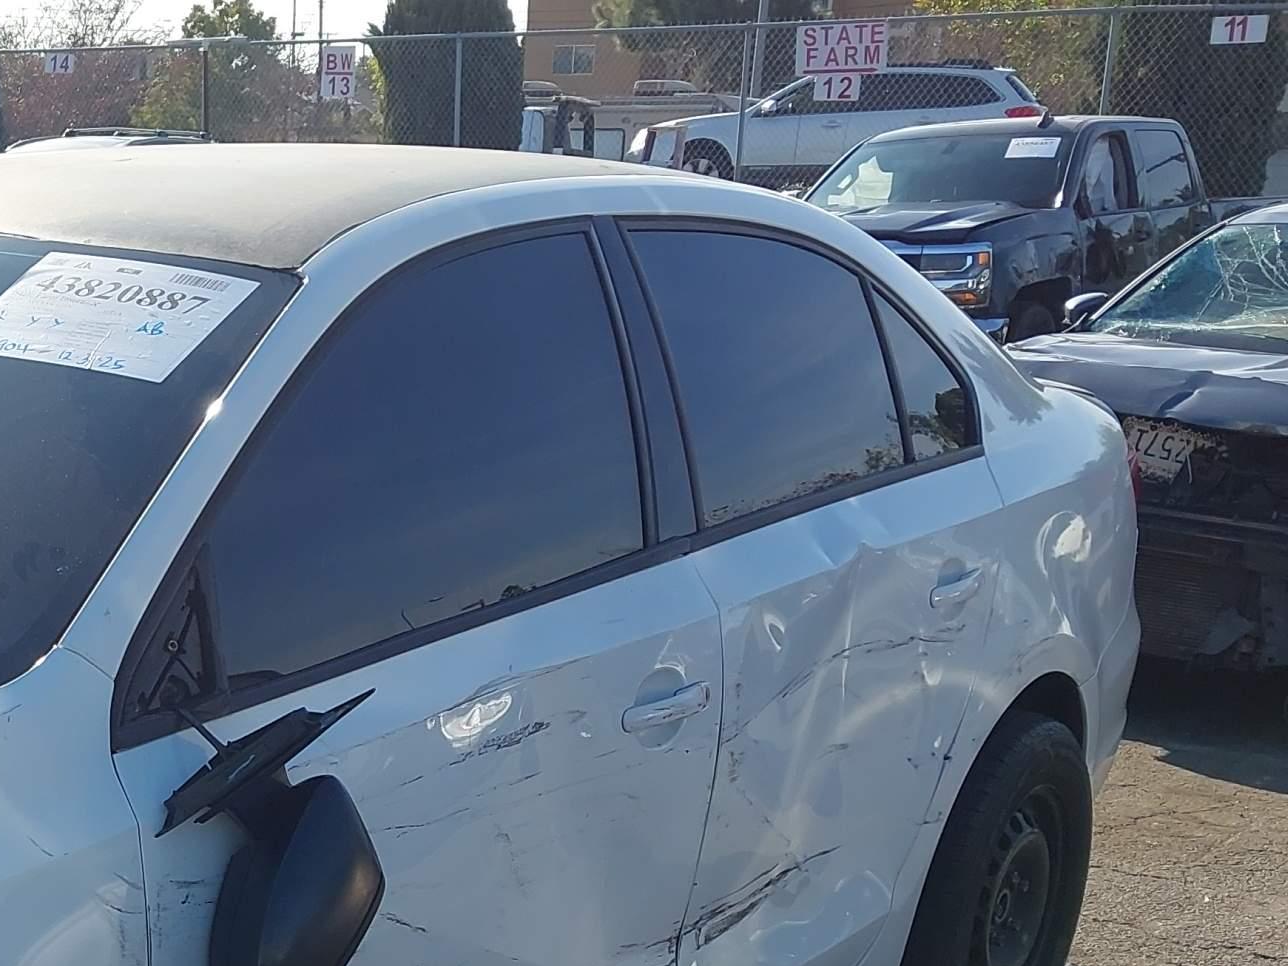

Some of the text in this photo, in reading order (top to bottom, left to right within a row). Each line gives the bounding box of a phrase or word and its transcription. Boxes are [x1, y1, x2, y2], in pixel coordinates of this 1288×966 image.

[803, 23, 885, 47] STATE
[1224, 15, 1249, 42] 11
[50, 54, 70, 73] 14
[326, 53, 353, 71] BW
[806, 45, 880, 68] FARM
[328, 76, 351, 96] 13
[822, 76, 853, 100] 12
[37, 275, 212, 315] 43820887
